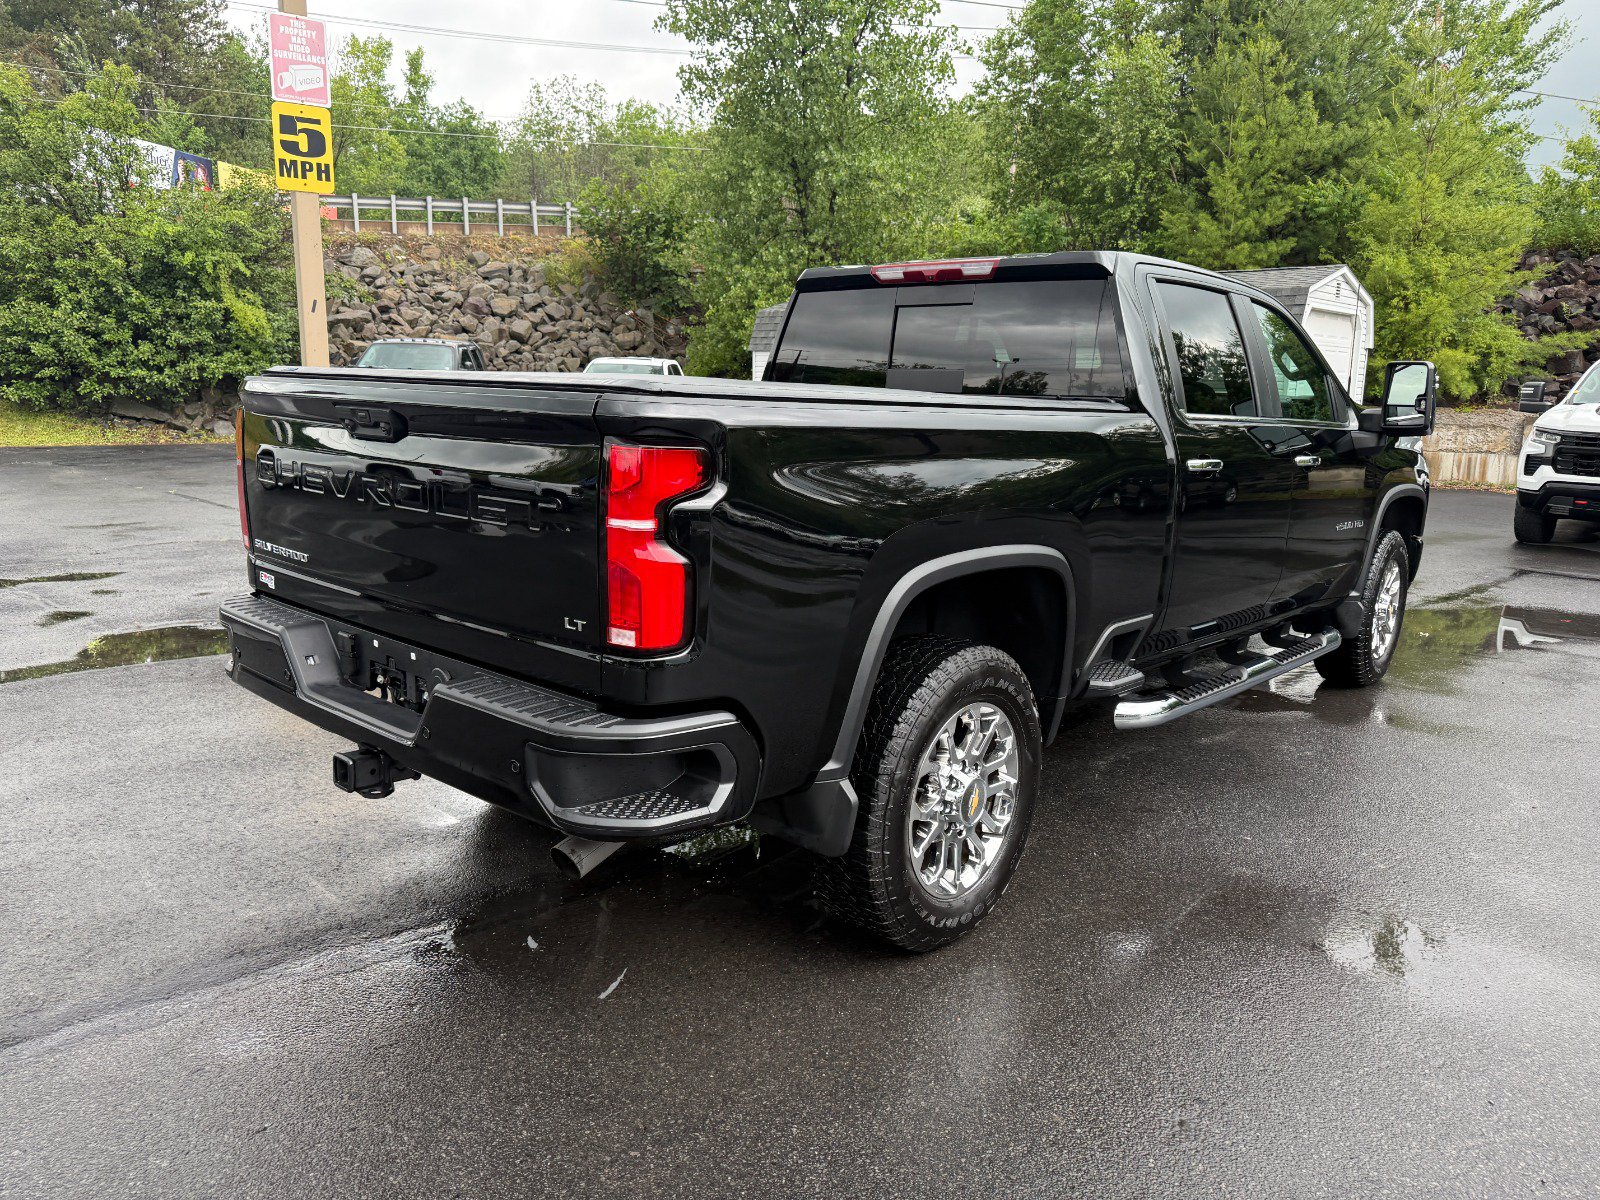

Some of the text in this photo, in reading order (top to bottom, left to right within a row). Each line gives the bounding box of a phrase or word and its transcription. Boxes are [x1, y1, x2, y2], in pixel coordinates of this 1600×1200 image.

[279, 25, 317, 39] PROPERTY
[289, 19, 306, 29] THIS
[291, 35, 306, 45] HAS
[288, 43, 311, 54] VIDEO
[273, 49, 326, 65] SURVEILLANCE
[298, 76, 321, 86] VIDEO
[279, 113, 327, 158] 5
[278, 157, 331, 182] MPH
[256, 448, 562, 532] CHEVROLET
[254, 538, 309, 563] SILVERADO
[563, 616, 586, 632] LT
